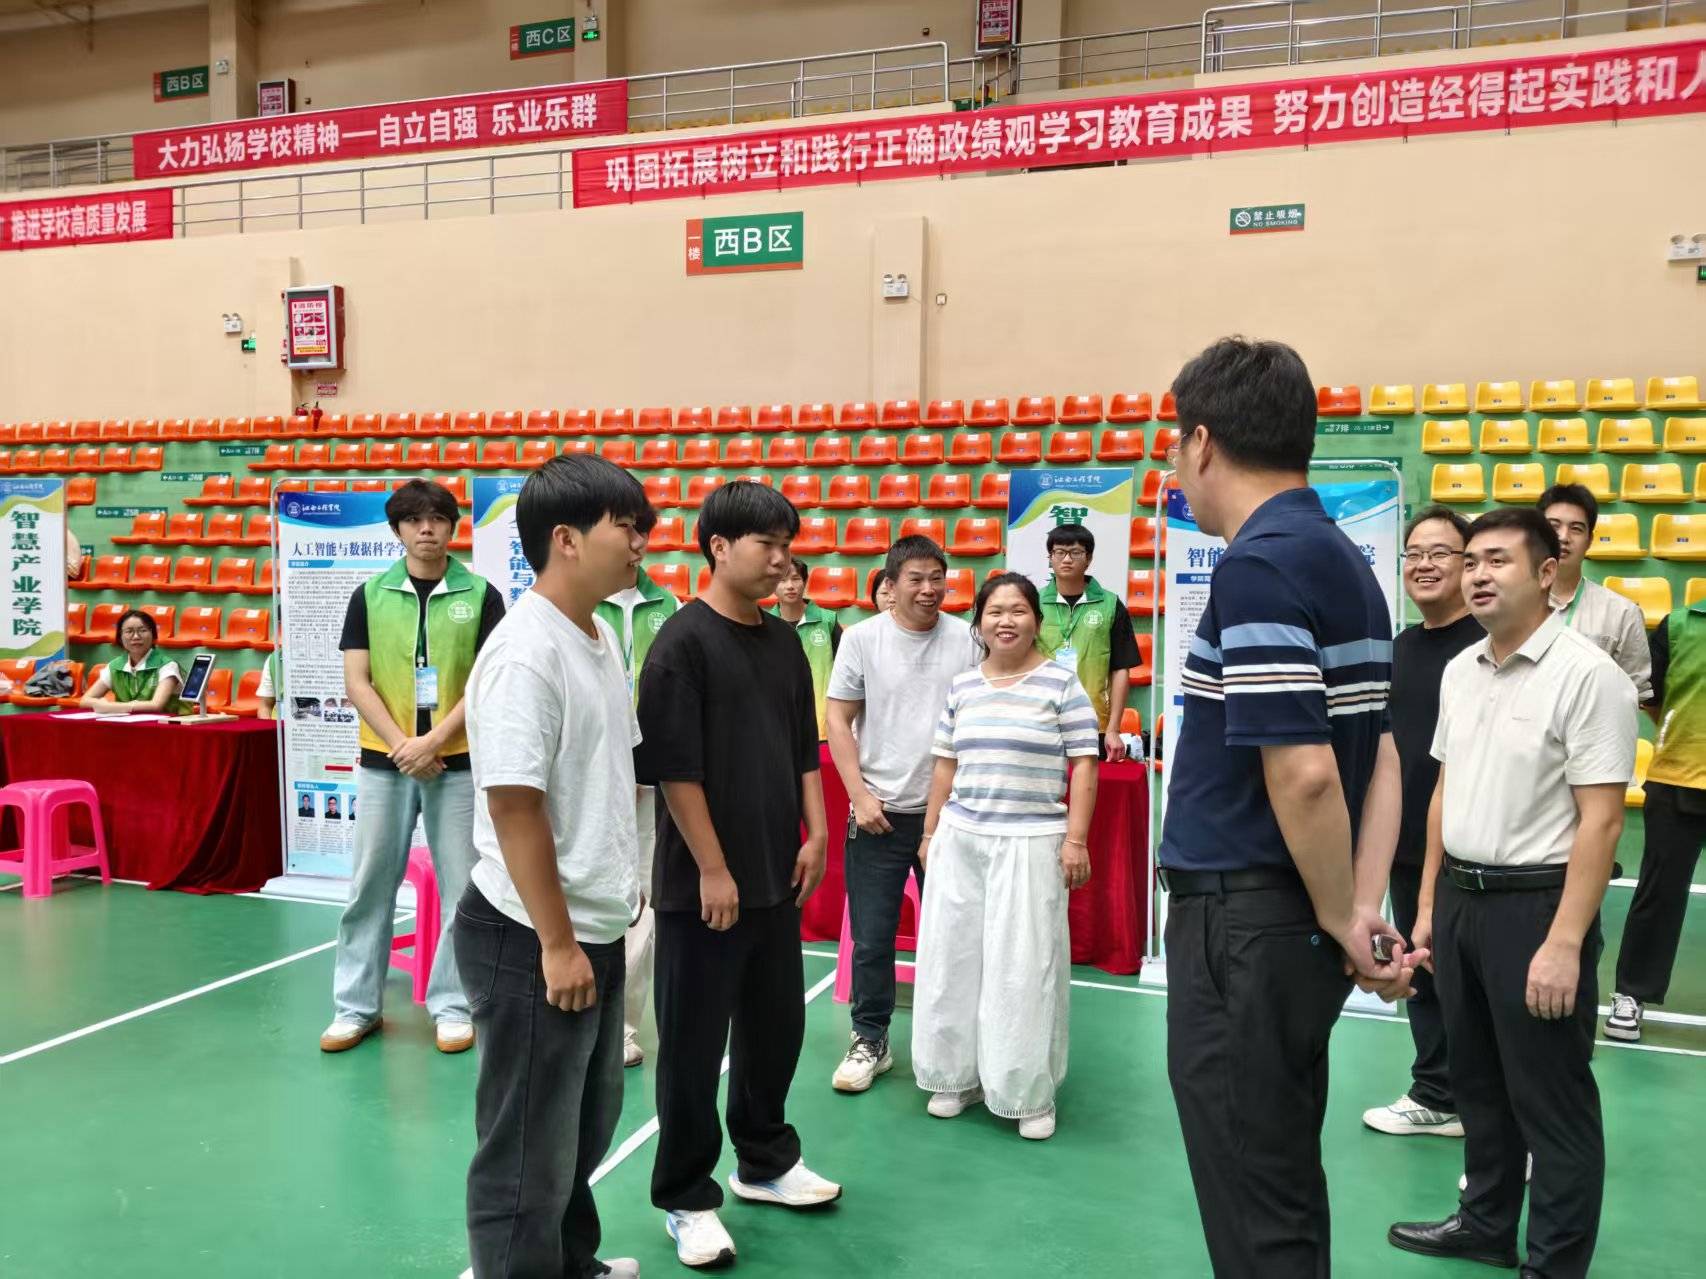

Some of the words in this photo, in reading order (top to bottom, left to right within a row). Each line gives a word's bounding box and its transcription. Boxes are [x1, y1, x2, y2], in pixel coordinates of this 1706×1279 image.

[526, 25, 571, 48] 西C区
[166, 73, 204, 92] 西B区
[491, 93, 597, 138] 乐业乐群
[605, 95, 1251, 194] 巩固拓展树立和践行正确政绩观学习教育成果
[11, 200, 147, 242] 推进学校高质量发展
[1253, 209, 1300, 220] 禁止吸烟
[687, 236, 701, 260] 一楼
[714, 225, 793, 257] 西B区
[11, 510, 42, 636] 智慧产业学院
